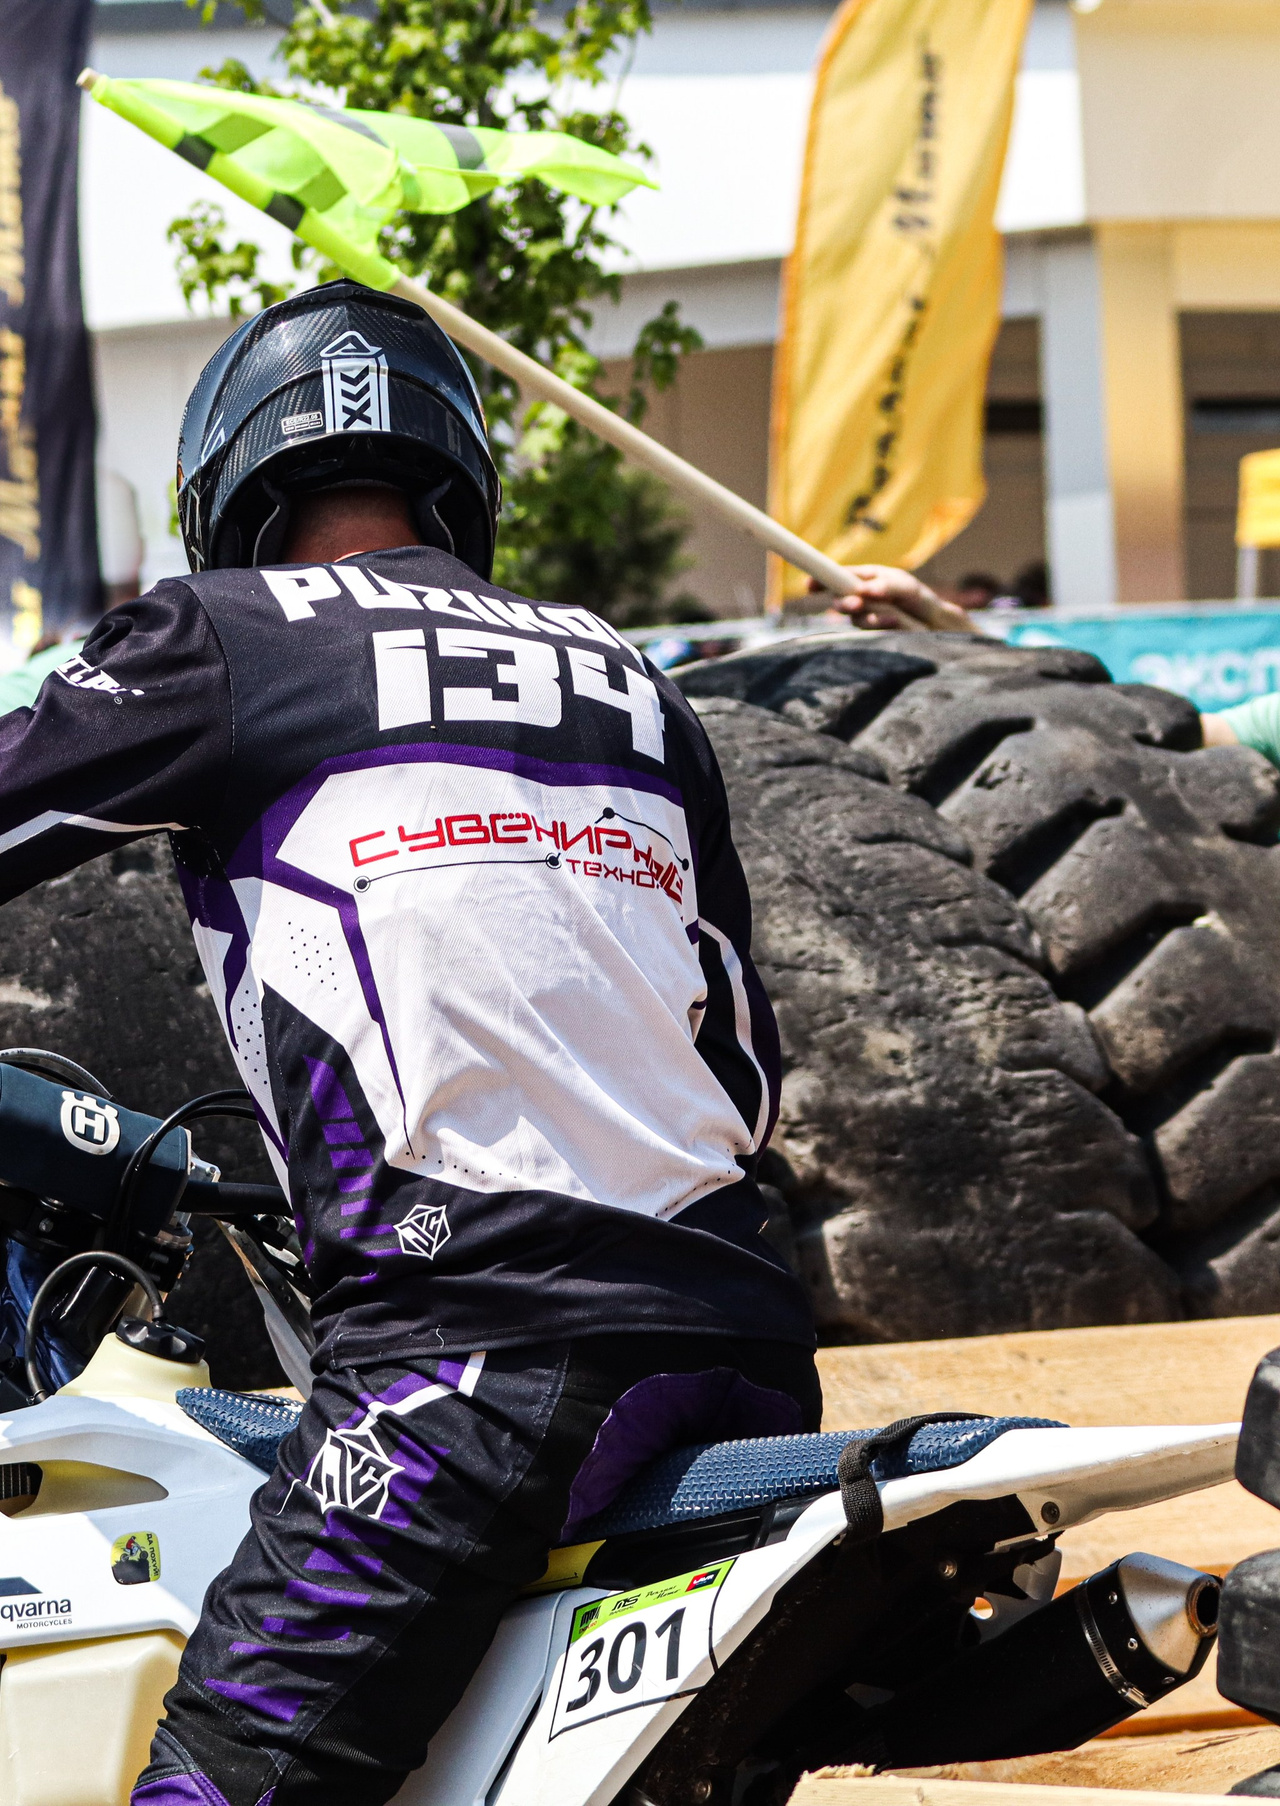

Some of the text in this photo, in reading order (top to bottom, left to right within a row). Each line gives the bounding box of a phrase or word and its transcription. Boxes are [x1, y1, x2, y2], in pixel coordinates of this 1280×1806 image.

[372, 627, 665, 764] 134
[16, 1618, 73, 1629] MOTORCYCLES
[566, 1606, 686, 1713] 301
